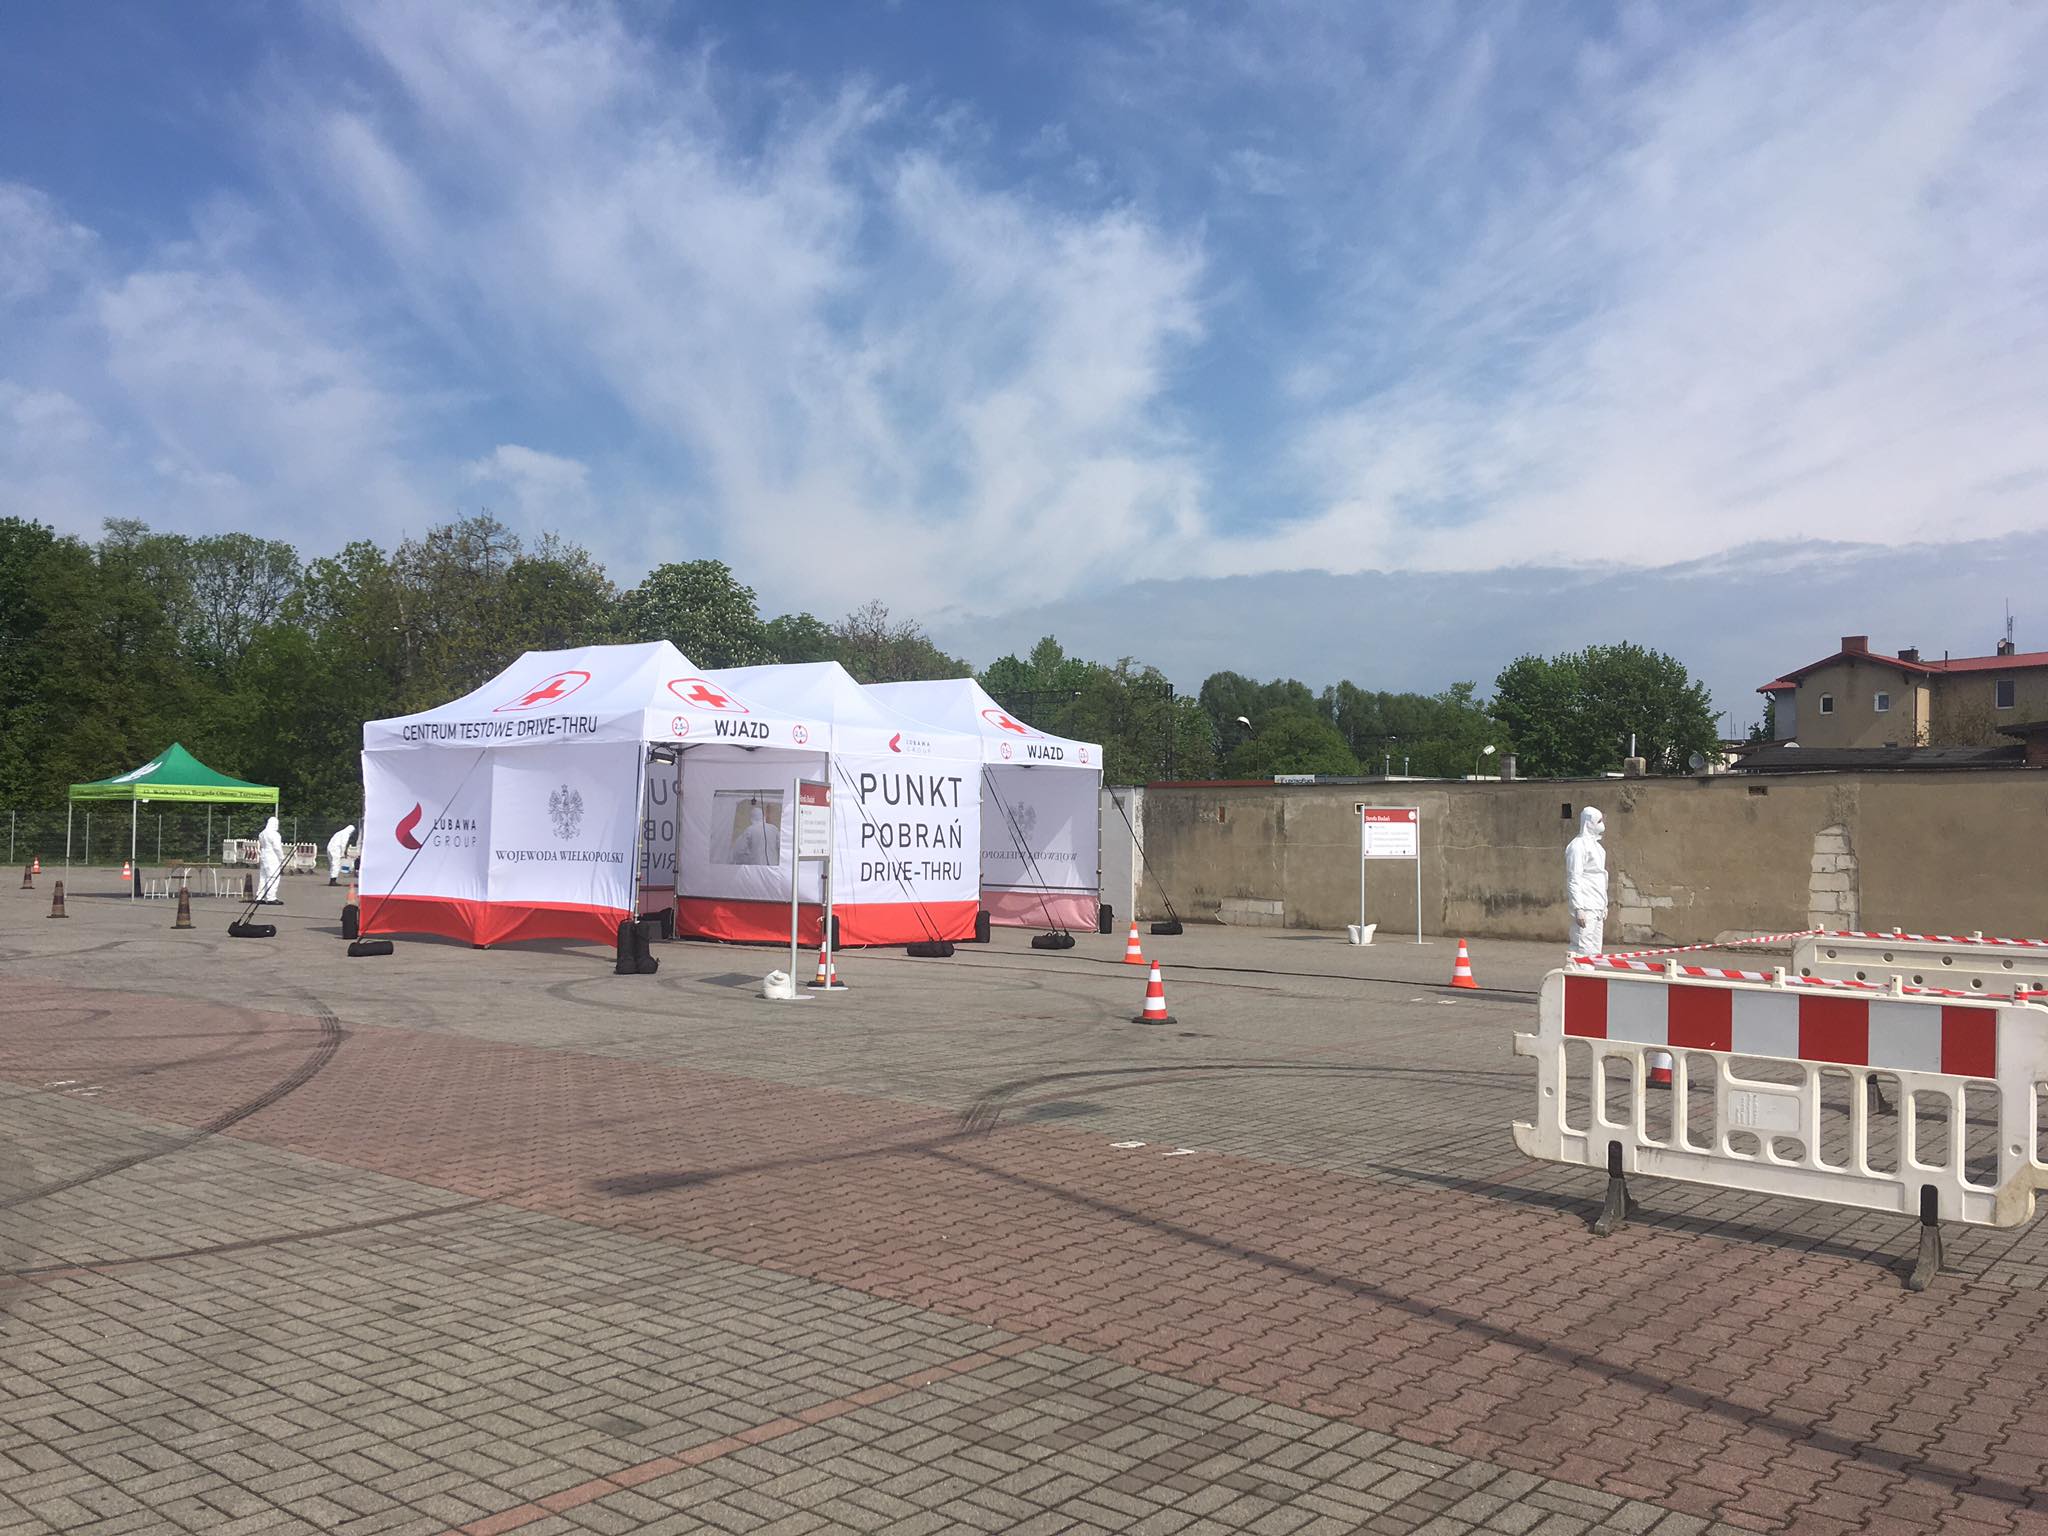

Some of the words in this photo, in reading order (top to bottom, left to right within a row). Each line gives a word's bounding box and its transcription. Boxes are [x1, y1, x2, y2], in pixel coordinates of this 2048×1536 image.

[403, 723, 456, 741] CENTRUM
[460, 721, 514, 739] TESTOWE
[517, 716, 598, 736] DRIVE-THRU
[715, 719, 770, 739] WJAZD
[1027, 745, 1064, 760] WJAZD
[860, 773, 962, 807] PUNKT
[433, 819, 477, 831] LUBAWA
[862, 818, 962, 848] POBRAŃ
[433, 835, 477, 847] GROUP
[496, 850, 557, 863] WOJEWODA
[560, 850, 624, 863] WIELKOPOLSKI
[861, 861, 962, 882] DRIVE-THRU
